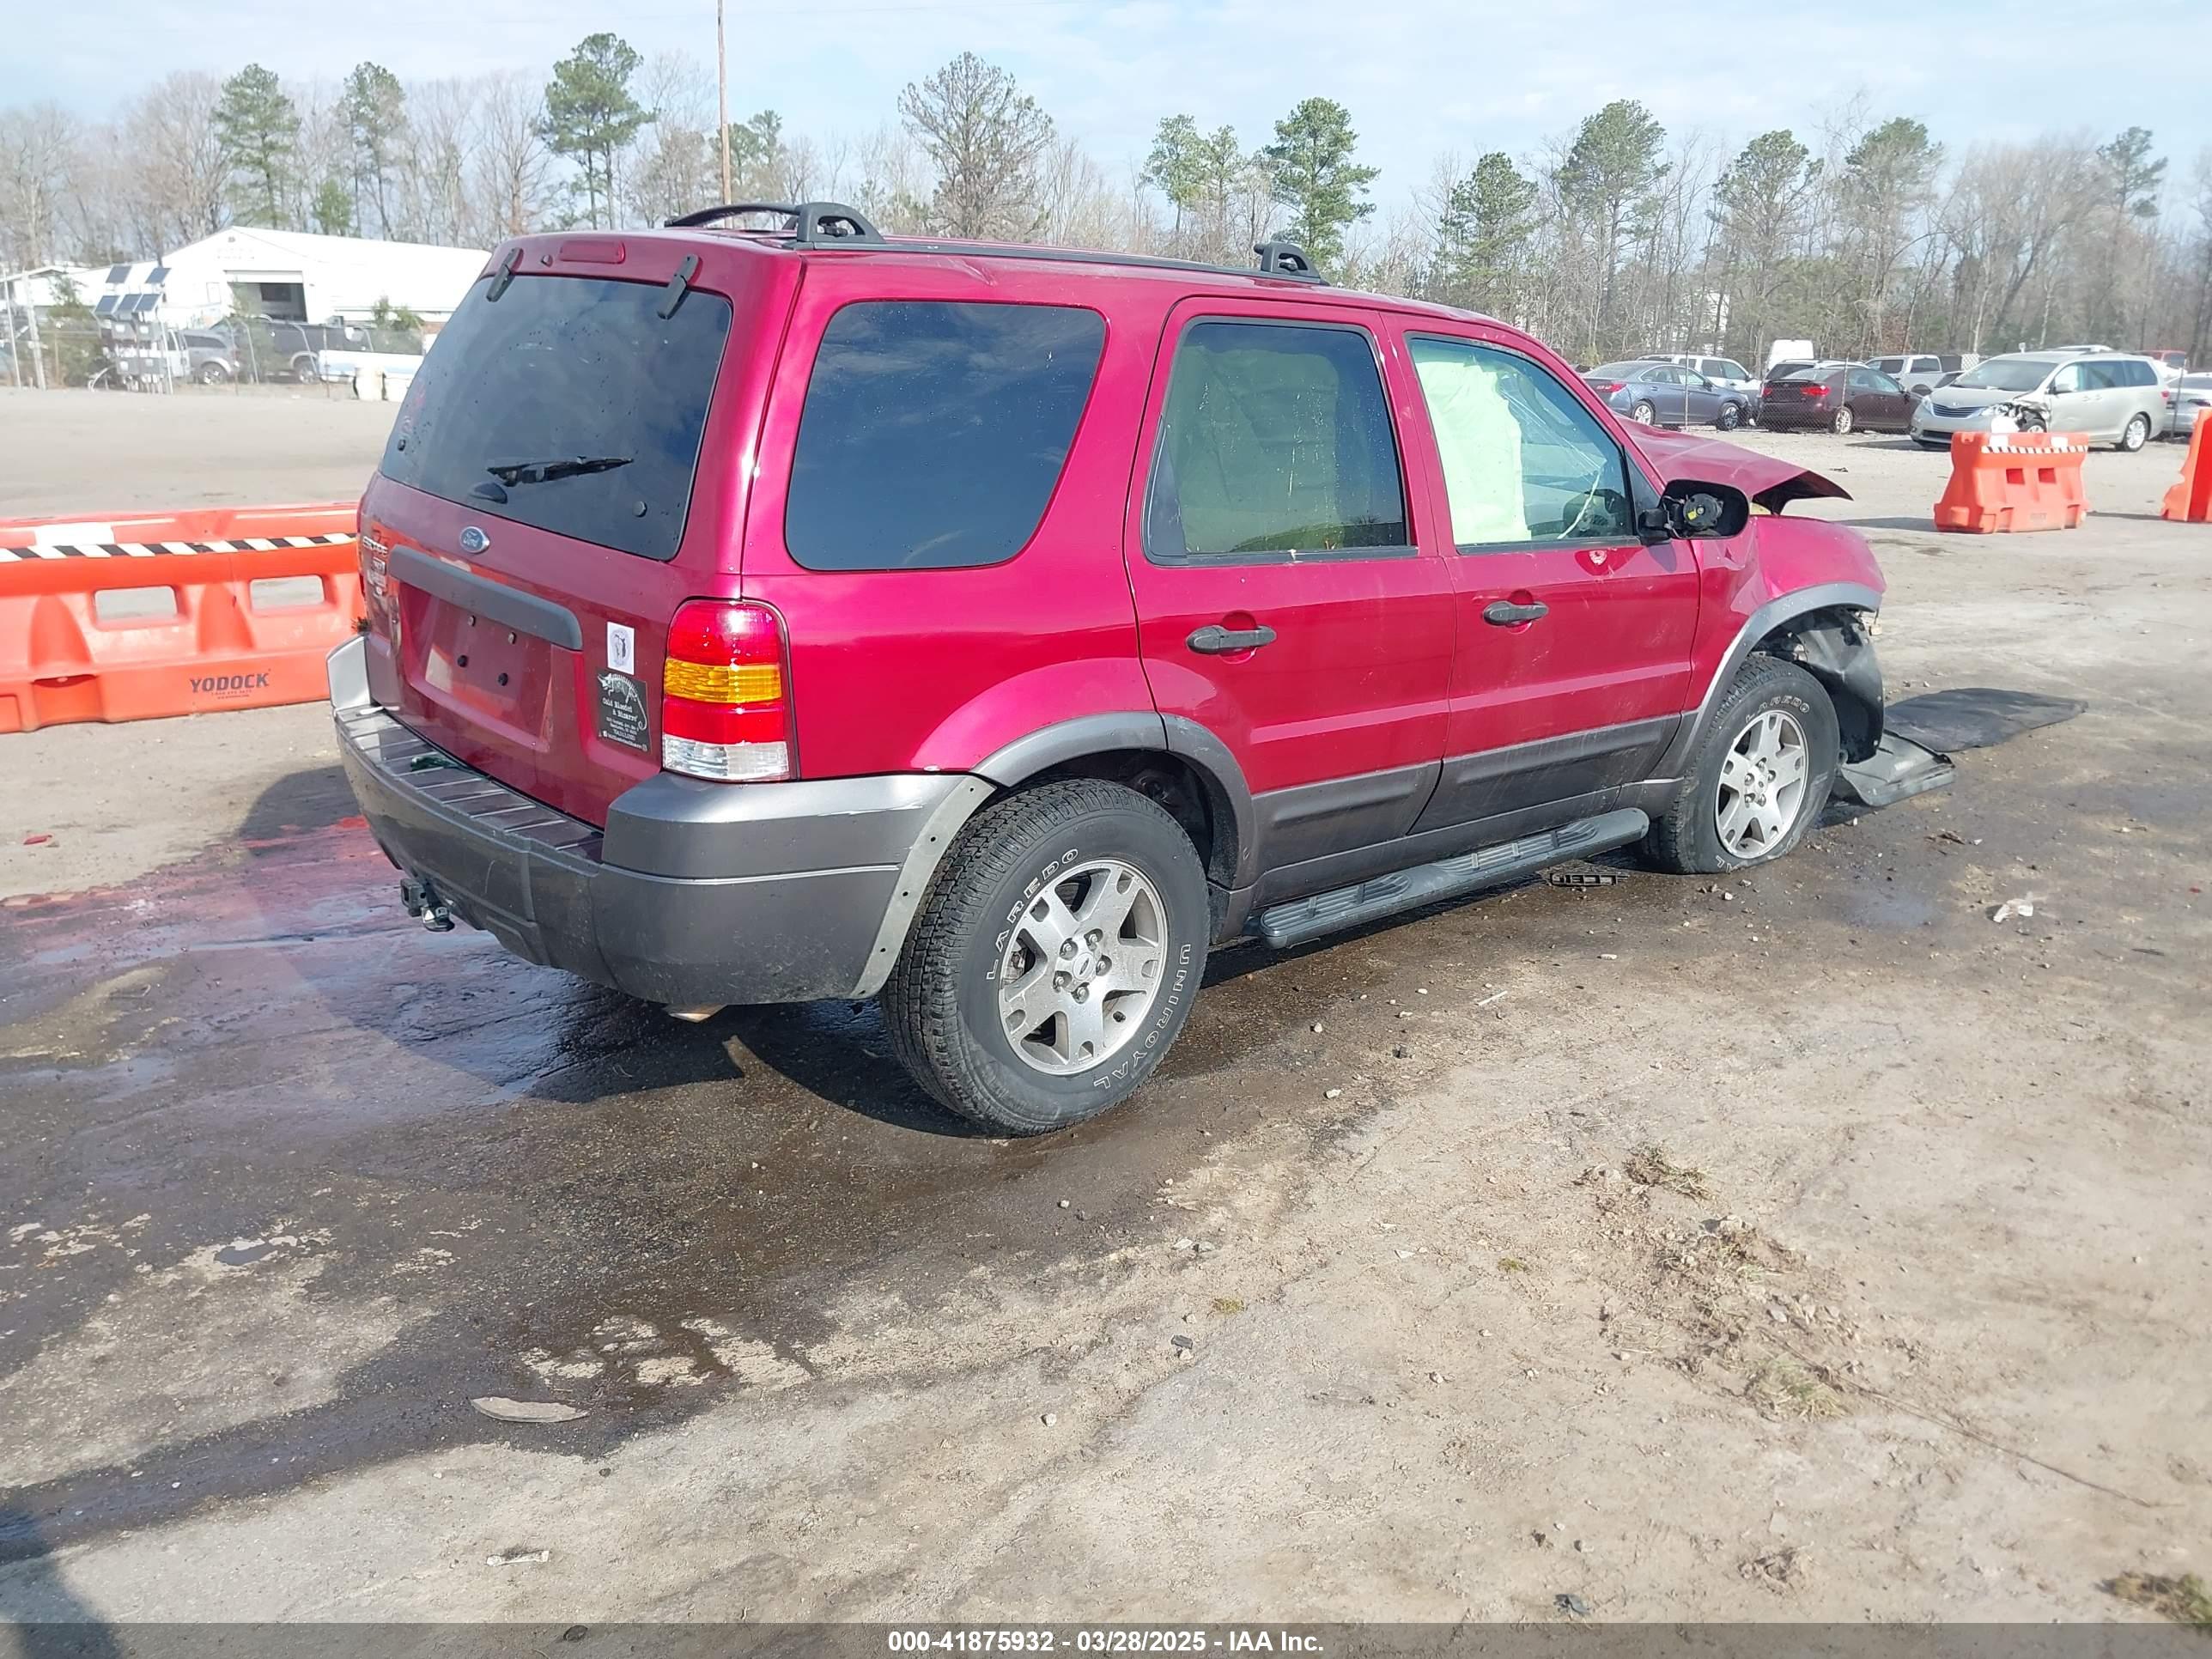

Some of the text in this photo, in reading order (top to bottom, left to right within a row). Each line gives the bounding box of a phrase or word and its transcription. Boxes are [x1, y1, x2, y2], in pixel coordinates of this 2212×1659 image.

[189, 672, 270, 694] YODOCK
[1745, 695, 1810, 724] LAREDO
[986, 848, 1079, 980] LAREDO
[1093, 944, 1191, 1090] UNIROYAL
